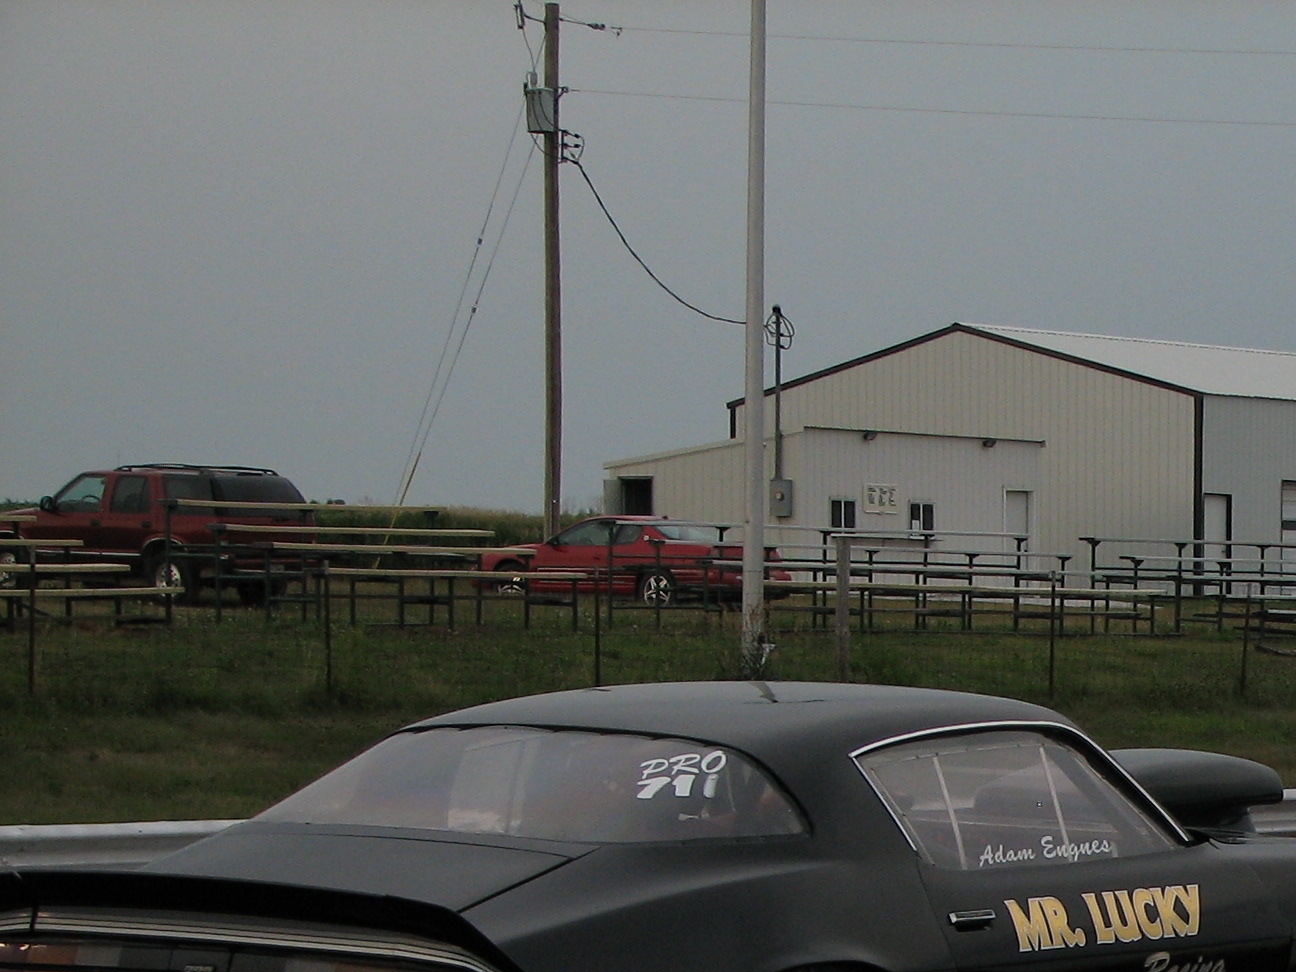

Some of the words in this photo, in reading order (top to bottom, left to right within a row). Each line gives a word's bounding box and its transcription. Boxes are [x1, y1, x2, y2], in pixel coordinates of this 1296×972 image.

[640, 750, 727, 779] PRO
[979, 844, 1036, 867] Adam
[1003, 895, 1087, 953] MR.
[1081, 883, 1200, 946] LUCKY
